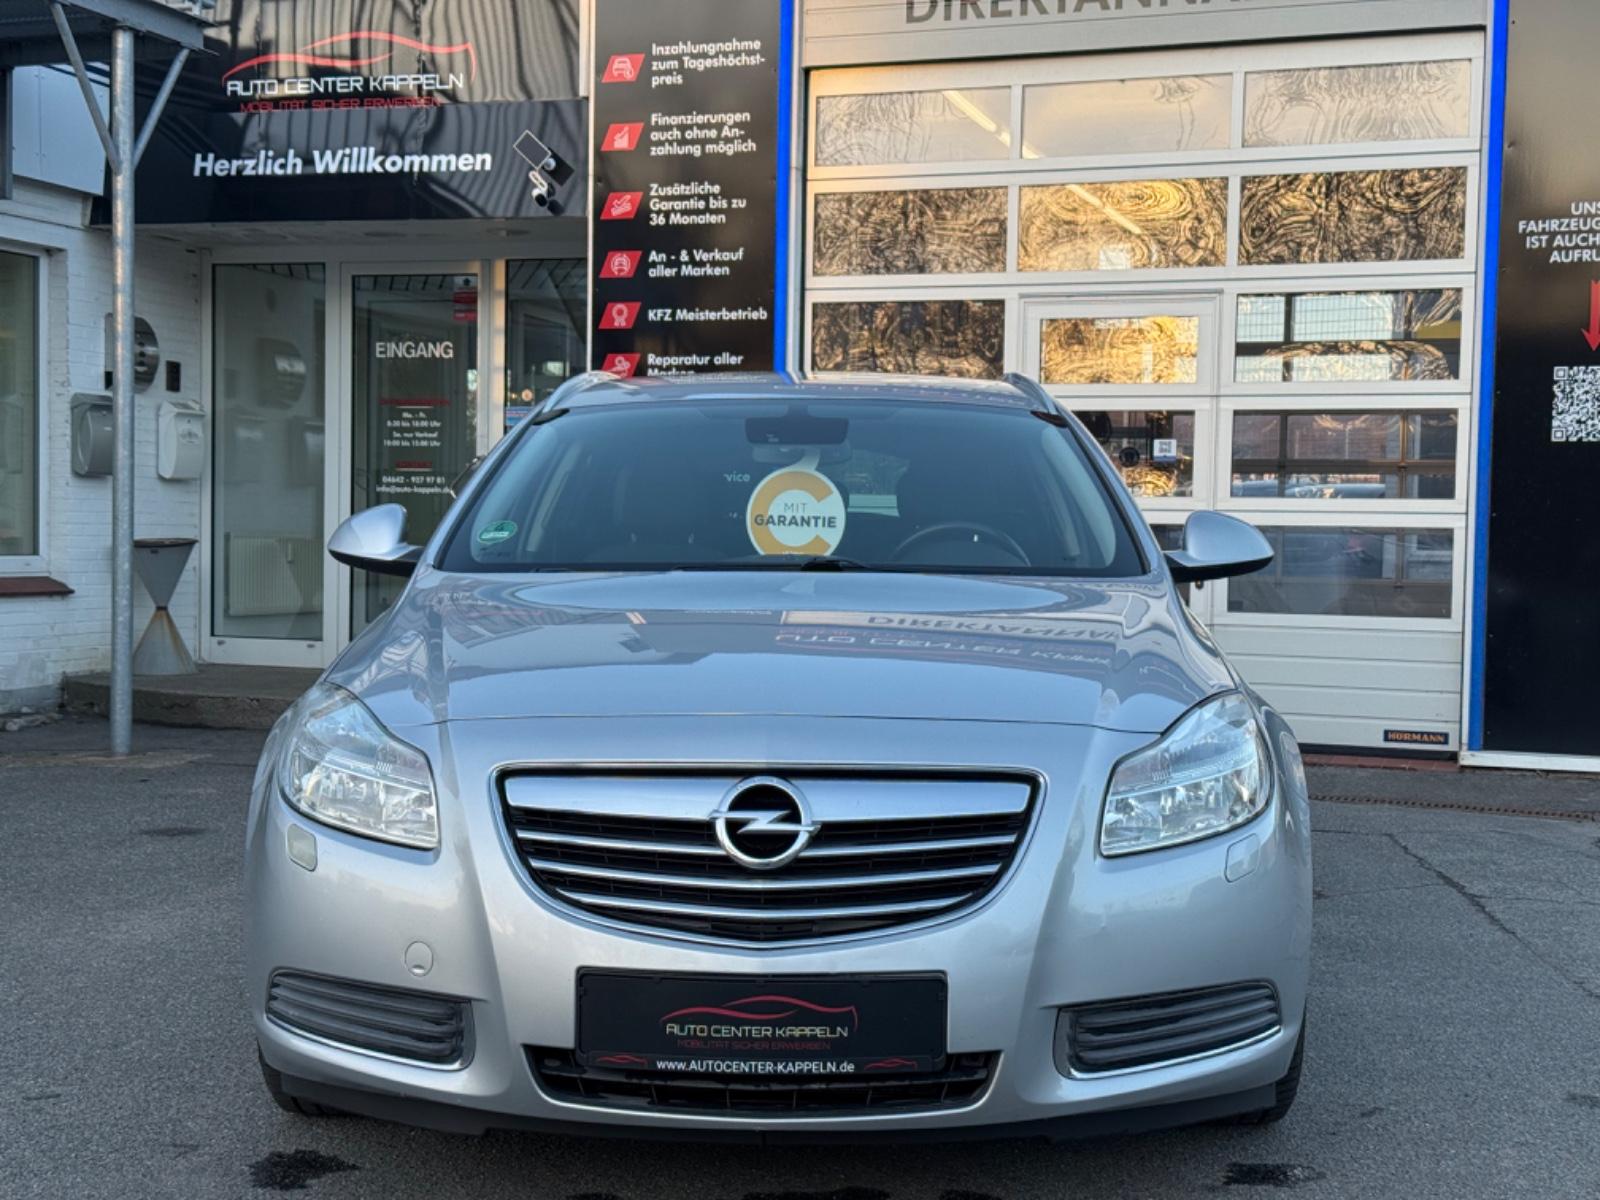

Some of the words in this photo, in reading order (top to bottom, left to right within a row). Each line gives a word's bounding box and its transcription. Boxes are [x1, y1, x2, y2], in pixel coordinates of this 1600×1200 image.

[652, 38, 761, 56] Inzahlungnahme
[651, 58, 679, 71] zum
[682, 53, 766, 71] Tageshöchst-
[226, 79, 278, 97] AUTO
[283, 77, 363, 95] CENTER
[369, 73, 464, 93] KAPPELN
[651, 72, 683, 88] preis
[651, 111, 751, 126] Finanzierungen
[650, 128, 681, 141] auch
[685, 126, 718, 139] ohne
[721, 126, 745, 138] An-
[650, 142, 702, 158] zahlung
[705, 139, 756, 156] möglich
[193, 150, 302, 177] Herzlich
[313, 147, 492, 175] Willkommen
[650, 181, 721, 196] Zusätzliche
[650, 197, 705, 211] Garantie
[709, 196, 727, 209] bis
[731, 198, 747, 209] zu
[649, 213, 666, 226] 36
[669, 211, 726, 225] Monaten
[1518, 217, 1600, 234] FAHRZEUG
[1526, 234, 1550, 249] IST
[1552, 232, 1600, 248] AUCH
[648, 250, 666, 262] An
[679, 249, 690, 262] &
[693, 248, 744, 261] Verkauf
[648, 265, 678, 277] aller
[680, 263, 729, 277] Marken
[648, 309, 672, 322] KFZ
[675, 306, 767, 321] Meisterbetrieb
[375, 341, 454, 359] EINGANG
[647, 353, 710, 368] Reparatur
[714, 351, 744, 365] aller
[783, 502, 809, 513] MIT
[754, 513, 837, 529] GARANTIE
[666, 1023, 708, 1036] AUTO
[711, 1025, 772, 1038] CENTER
[776, 1026, 848, 1038] KAPPELN
[656, 1059, 855, 1075] www.AUTOCENTER-KAPPELN.de
